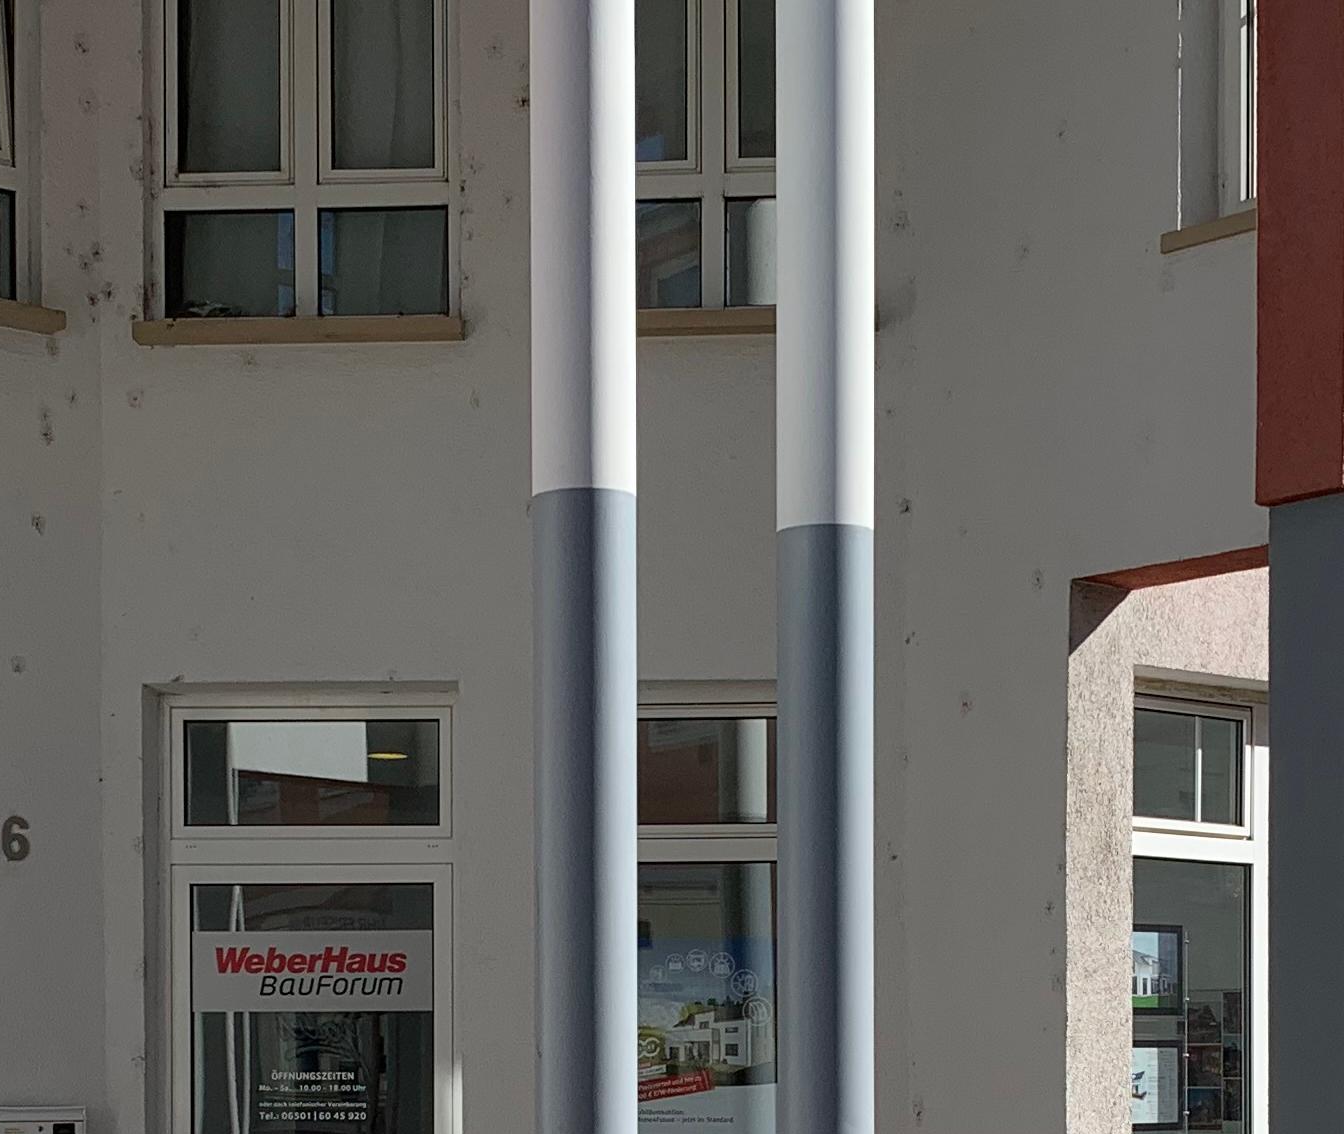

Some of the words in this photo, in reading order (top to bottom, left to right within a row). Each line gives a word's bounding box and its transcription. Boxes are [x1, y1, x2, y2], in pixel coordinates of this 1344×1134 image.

[215, 947, 407, 974] WeberHaus
[259, 975, 404, 996] BauForum
[271, 1069, 355, 1081] ÖFFNUNGSZEITEN
